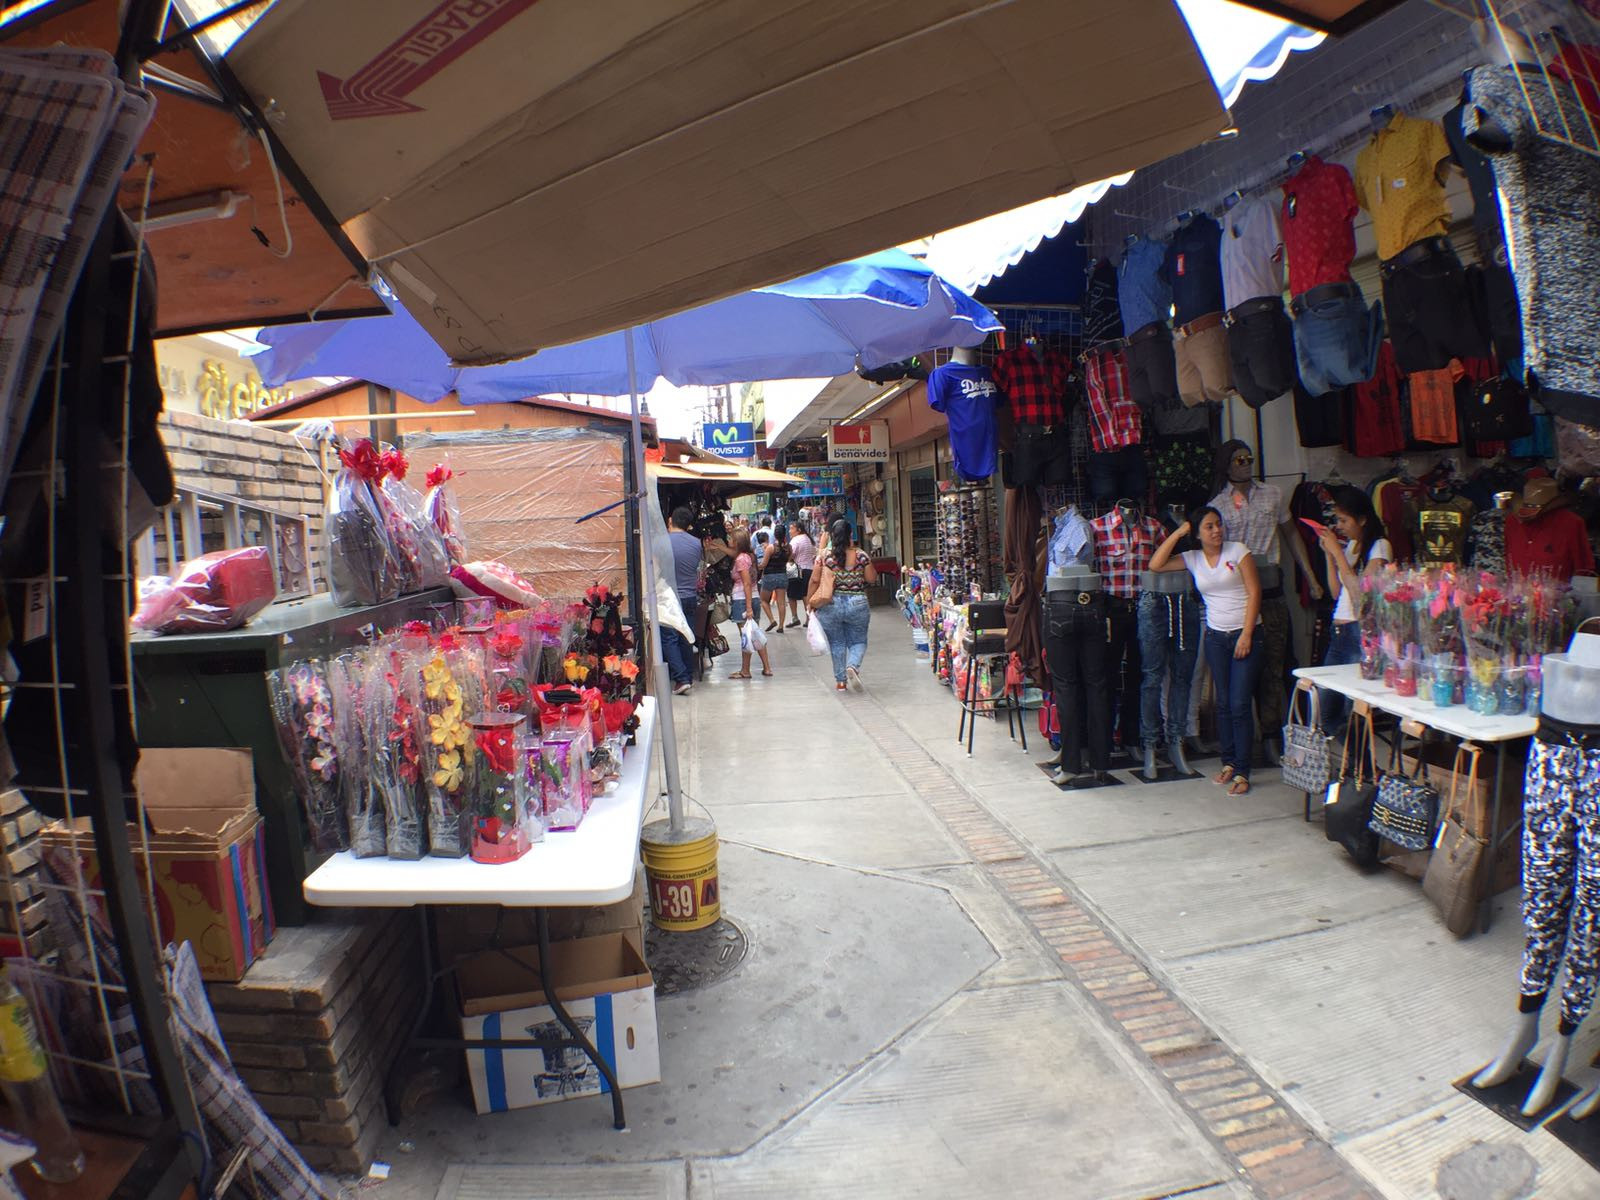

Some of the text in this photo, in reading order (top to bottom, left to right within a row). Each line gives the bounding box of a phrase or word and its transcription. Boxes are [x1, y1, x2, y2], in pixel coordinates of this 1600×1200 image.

[396, 0, 508, 57] RAGIL
[707, 446, 746, 455] movistar
[833, 448, 888, 458] benavides
[654, 883, 694, 918] J-39
